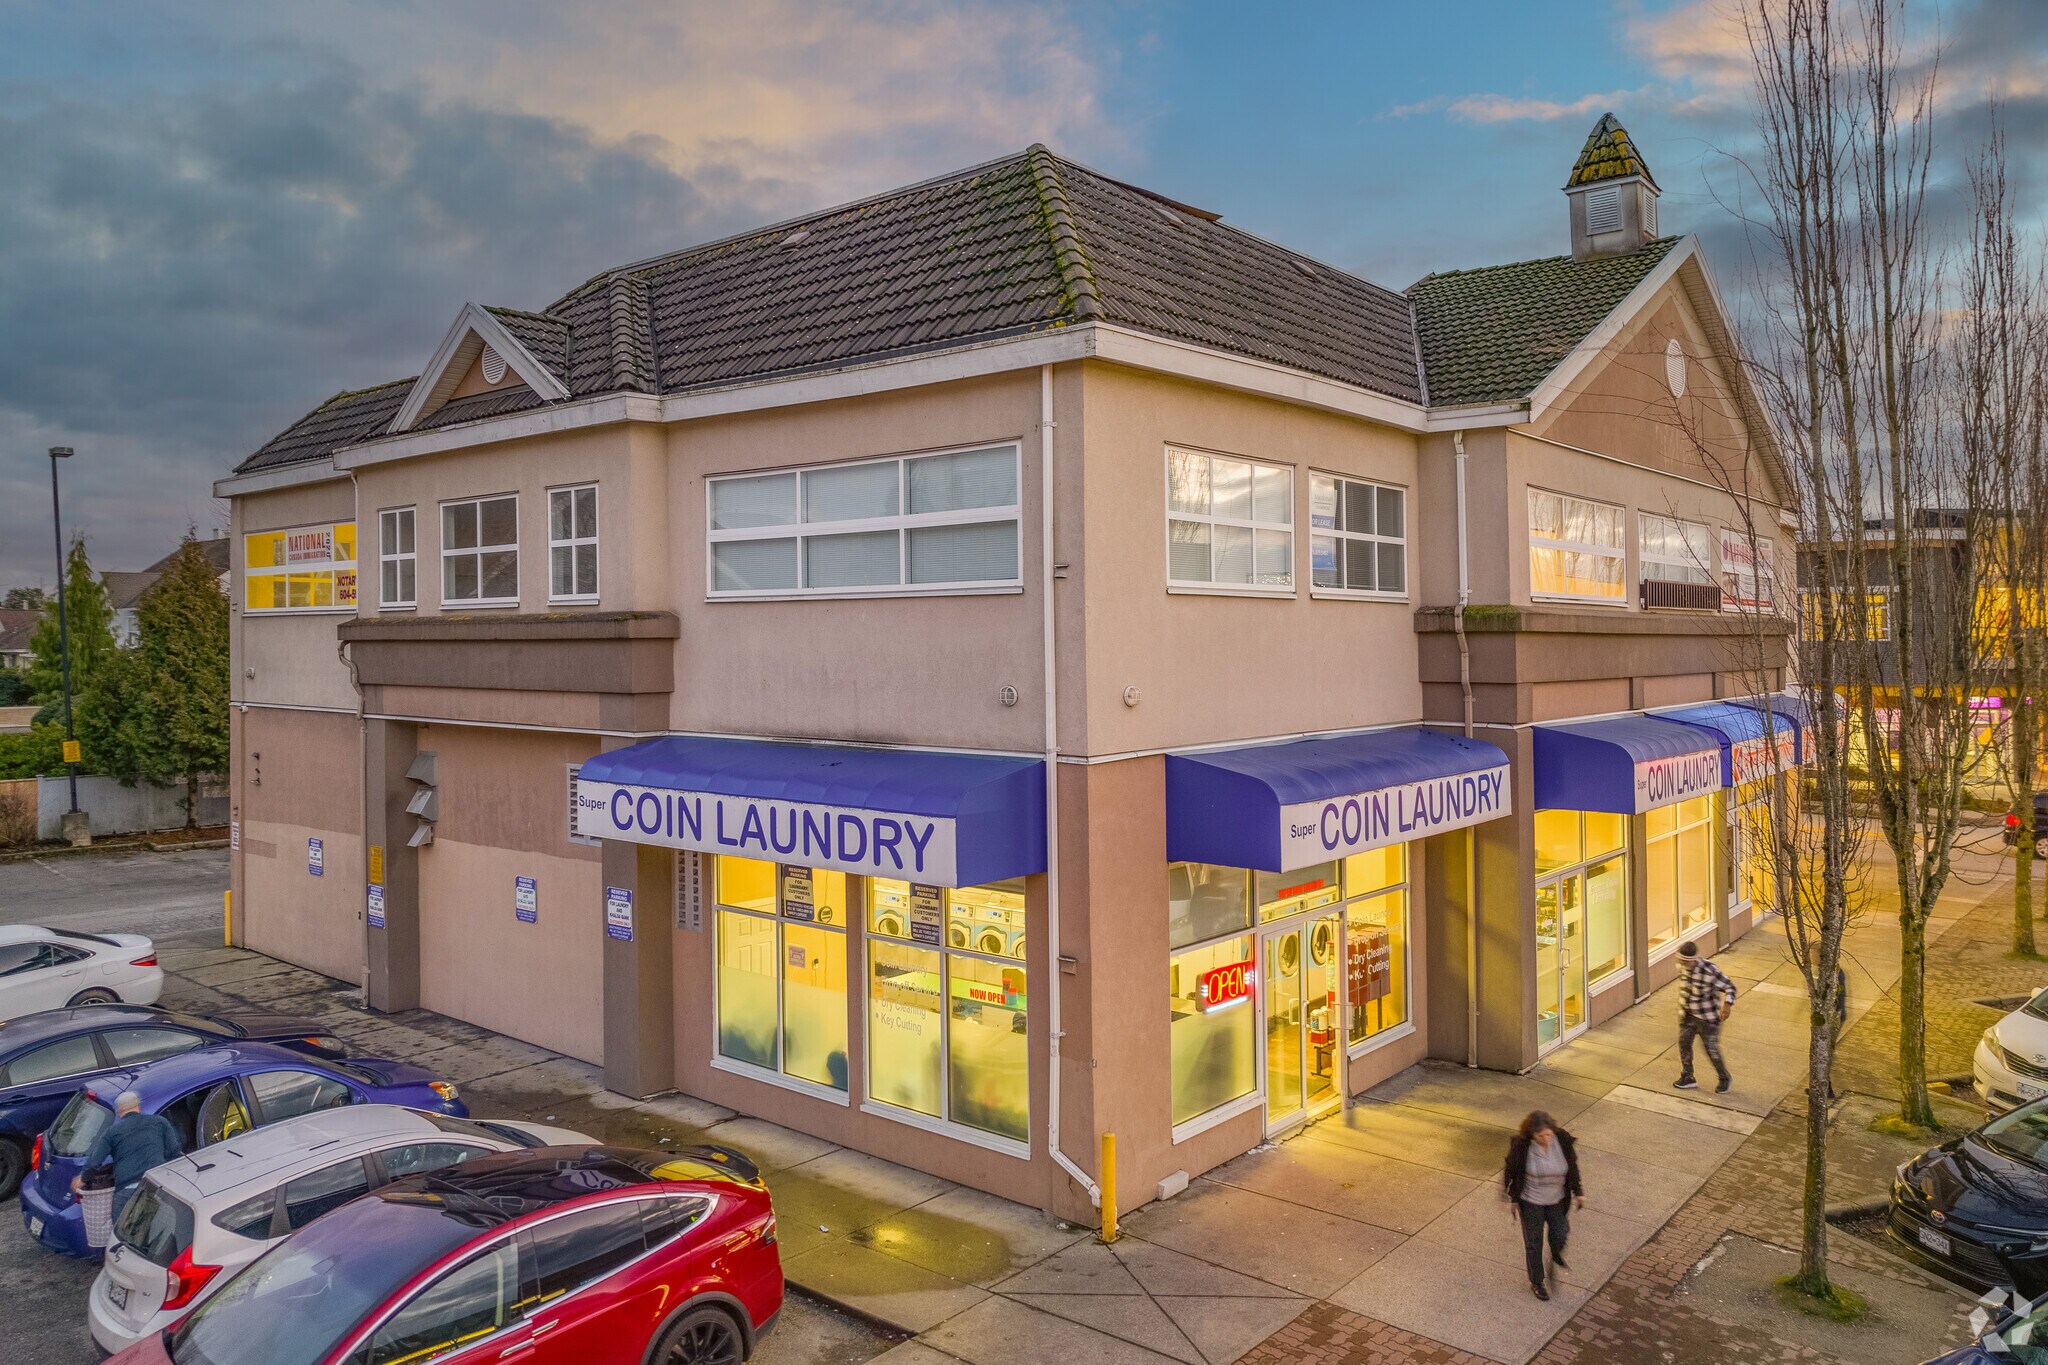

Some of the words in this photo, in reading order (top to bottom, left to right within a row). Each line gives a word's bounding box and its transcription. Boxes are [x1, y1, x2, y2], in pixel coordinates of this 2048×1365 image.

[289, 533, 325, 551] NATIONAL
[337, 575, 356, 587] NOTAR
[1637, 780, 1647, 791] Super
[1648, 762, 1674, 802] COIN
[1677, 753, 1720, 795] LAUNDRY
[1291, 823, 1316, 839] Super
[1320, 792, 1389, 851] COIN
[1399, 770, 1503, 833] LAUNDRY
[578, 796, 606, 811] Super
[611, 789, 702, 842] COIN
[717, 800, 935, 873] LAUNDRY
[1354, 953, 1366, 965] Dry
[1366, 943, 1392, 960] Cleaning
[1368, 960, 1390, 975] Cutting
[1208, 965, 1246, 1003] OPEN
[969, 988, 986, 1001] NOW
[987, 991, 1006, 1004] OPEN
[895, 1000, 927, 1020] Cleaning
[881, 1012, 895, 1029] Key
[895, 1016, 922, 1036] Cutting
